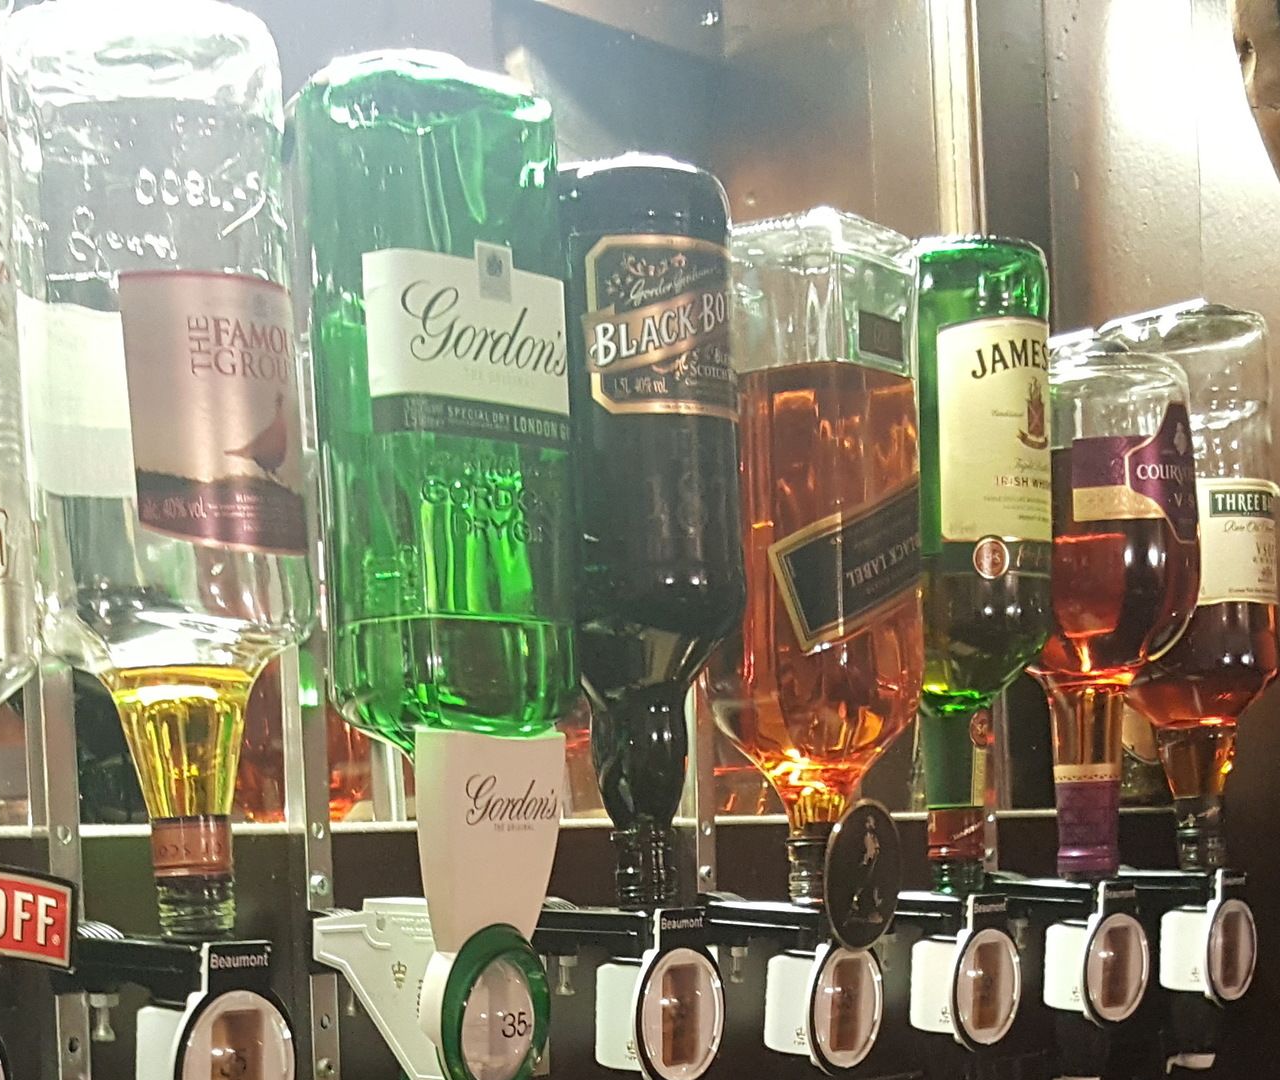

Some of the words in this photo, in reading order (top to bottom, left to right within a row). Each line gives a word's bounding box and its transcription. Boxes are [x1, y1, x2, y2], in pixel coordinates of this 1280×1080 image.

[187, 315, 213, 376] THE
[401, 280, 568, 377] Gordon's
[590, 302, 697, 367] BLACK
[513, 416, 557, 438] LONDON
[1215, 493, 1261, 512] THREE
[465, 774, 557, 826] Gordon's
[660, 917, 704, 931] Beaumont
[210, 952, 269, 969] Beaumont
